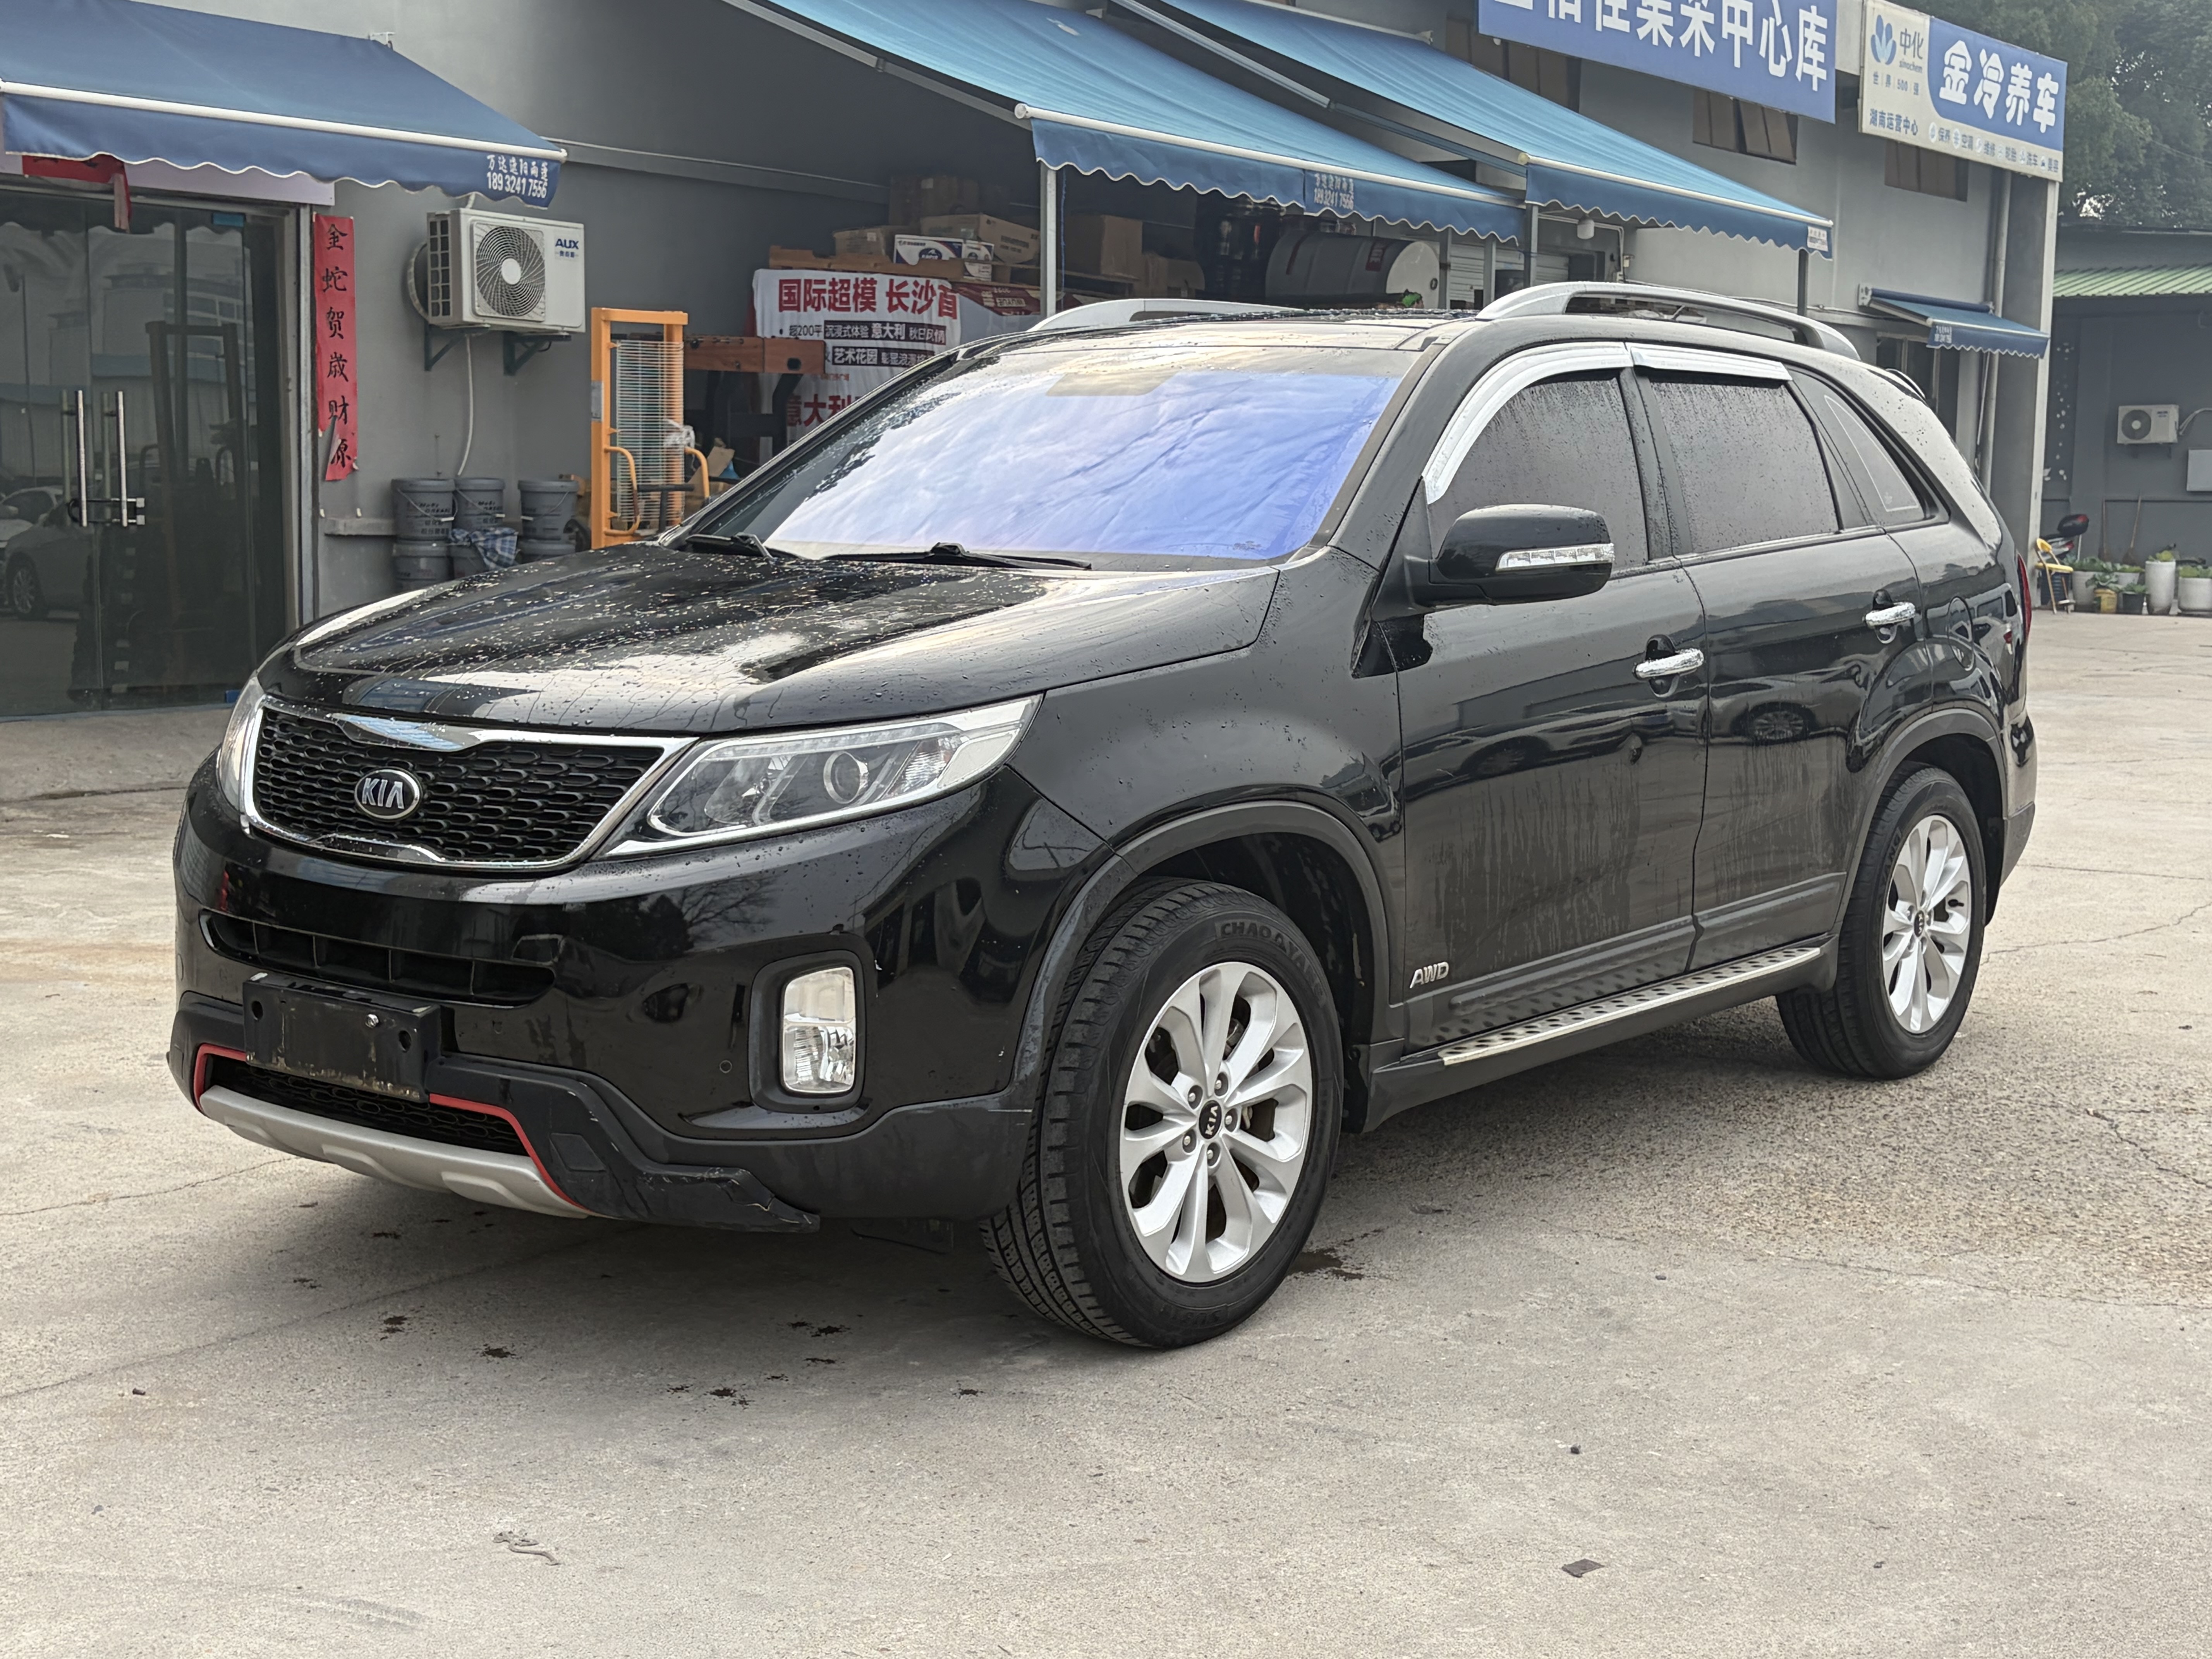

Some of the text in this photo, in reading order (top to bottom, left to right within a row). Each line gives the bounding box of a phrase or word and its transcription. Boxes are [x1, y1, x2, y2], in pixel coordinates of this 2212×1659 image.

[1494, 0, 1828, 92] 集采中心库
[1899, 28, 1924, 59] 中化
[1939, 40, 2059, 134] 金冷养车
[1870, 108, 1918, 136] 湖南运营中心
[487, 172, 503, 191] 189
[505, 175, 527, 195] 3241
[555, 238, 579, 250] AUX
[778, 277, 878, 313] 国际超模
[871, 322, 906, 340] 意大利
[909, 326, 945, 343] 秋日风情
[834, 347, 878, 365] 艺术花园
[362, 778, 405, 809] KIA
[1410, 961, 1449, 989] AWD
[1205, 1106, 1218, 1135] KIA
